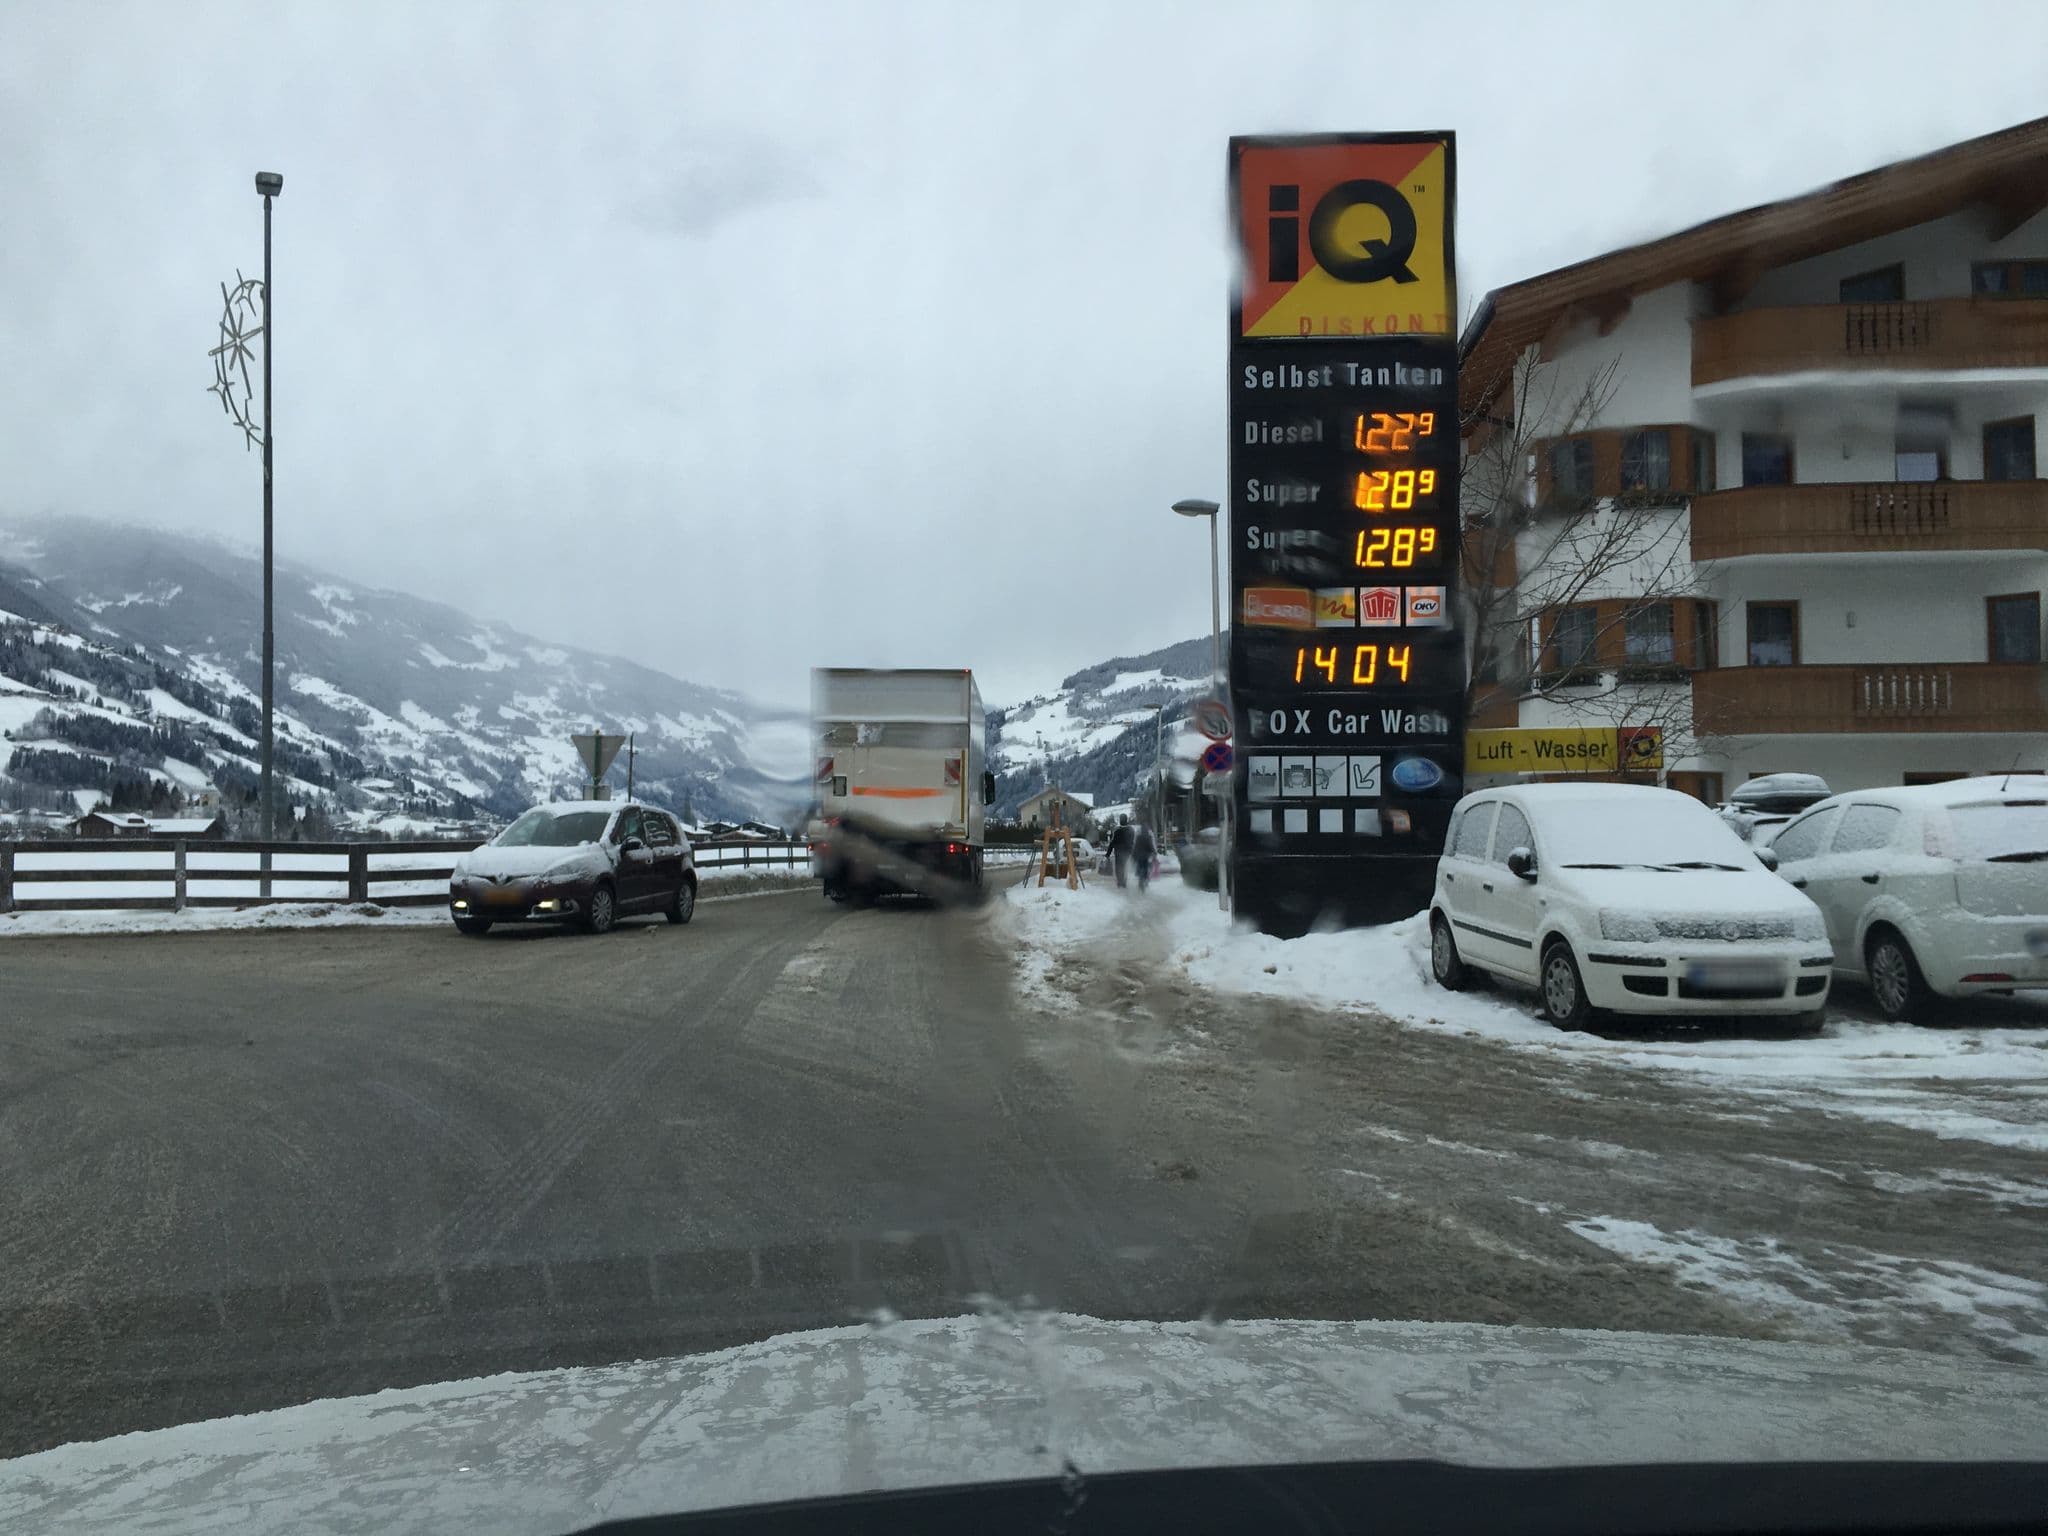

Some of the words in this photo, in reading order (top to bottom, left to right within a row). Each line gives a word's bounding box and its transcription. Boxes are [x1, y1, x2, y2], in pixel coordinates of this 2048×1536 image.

[1269, 179, 1420, 284] iQ
[1299, 313, 1449, 336] DISKONT
[1244, 364, 1333, 389] Selbst
[1347, 362, 1442, 386] Tanken
[1245, 419, 1323, 445] Diesel
[1247, 478, 1321, 506] Super
[1414, 602, 1436, 612] DKV
[1250, 709, 1311, 734] FOX
[1328, 709, 1369, 734] Car
[1381, 709, 1448, 734] Wash
[1477, 740, 1514, 760] Luft
[1534, 739, 1609, 759] Wasser
